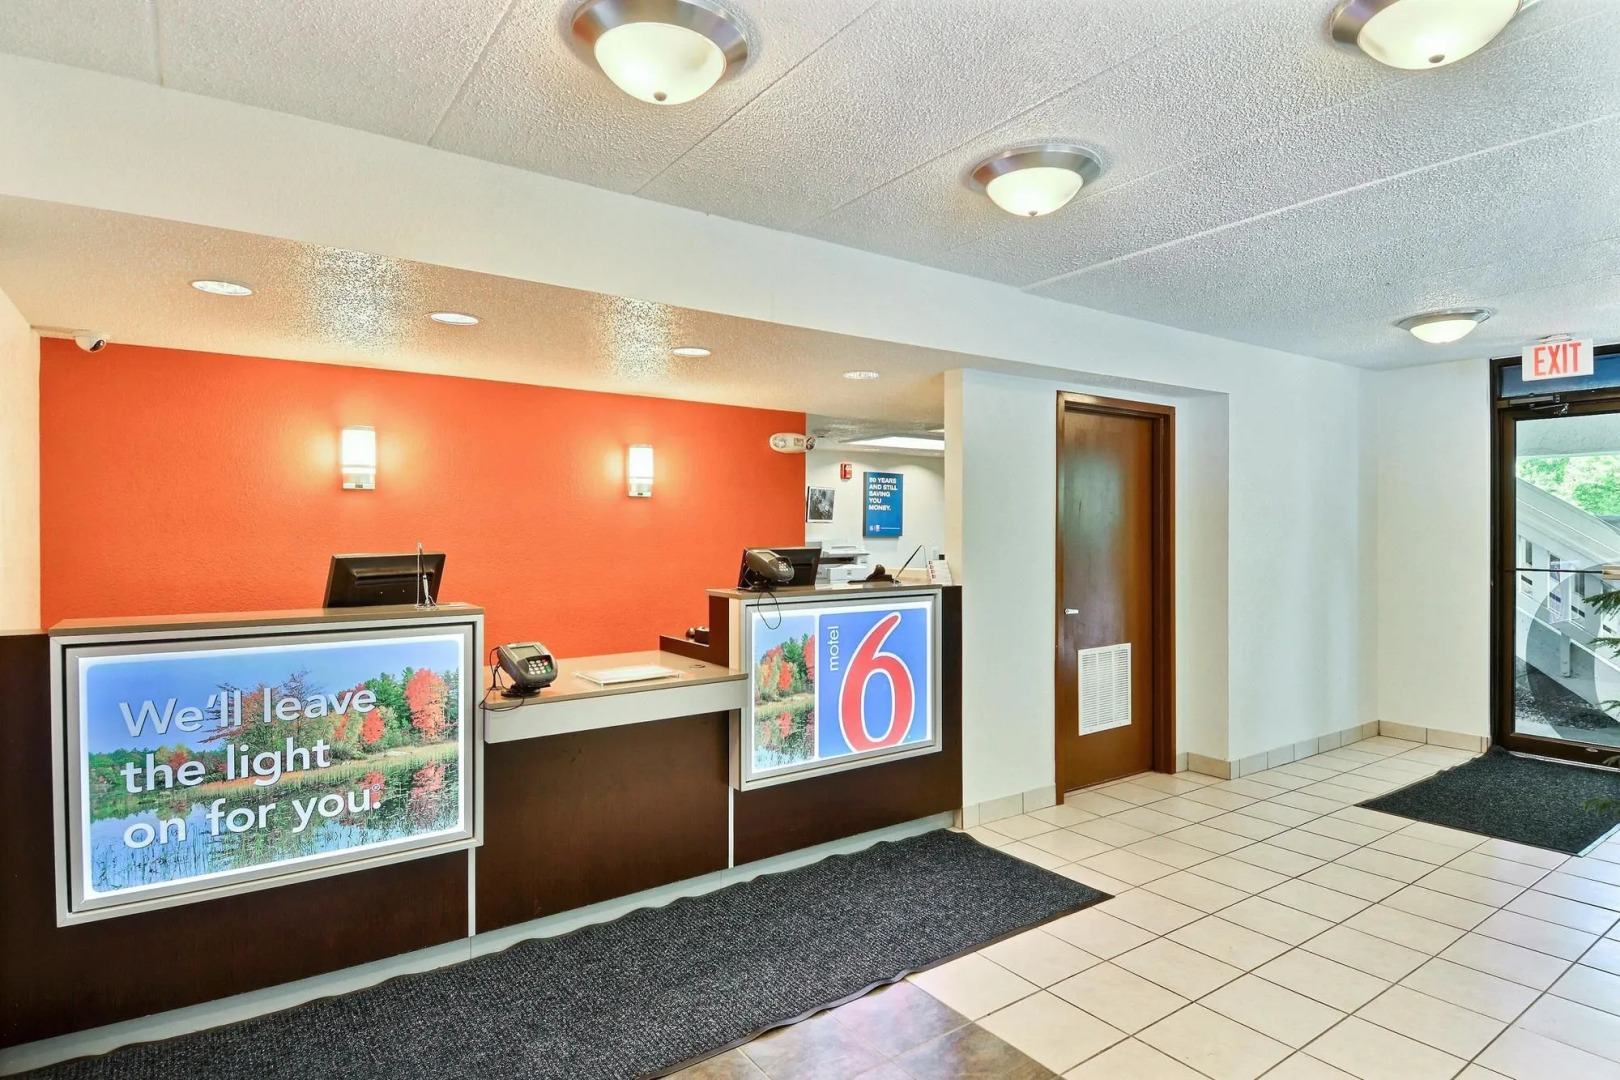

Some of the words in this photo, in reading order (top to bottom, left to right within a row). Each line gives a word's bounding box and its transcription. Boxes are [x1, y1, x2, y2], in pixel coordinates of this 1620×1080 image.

[1534, 342, 1581, 377] EXIT
[828, 626, 840, 672] motel
[838, 611, 915, 753] 6
[119, 690, 242, 738] We'll
[262, 686, 377, 724] leave
[120, 753, 206, 795] the
[226, 736, 331, 787] light
[123, 812, 187, 850] on
[206, 796, 277, 837] for
